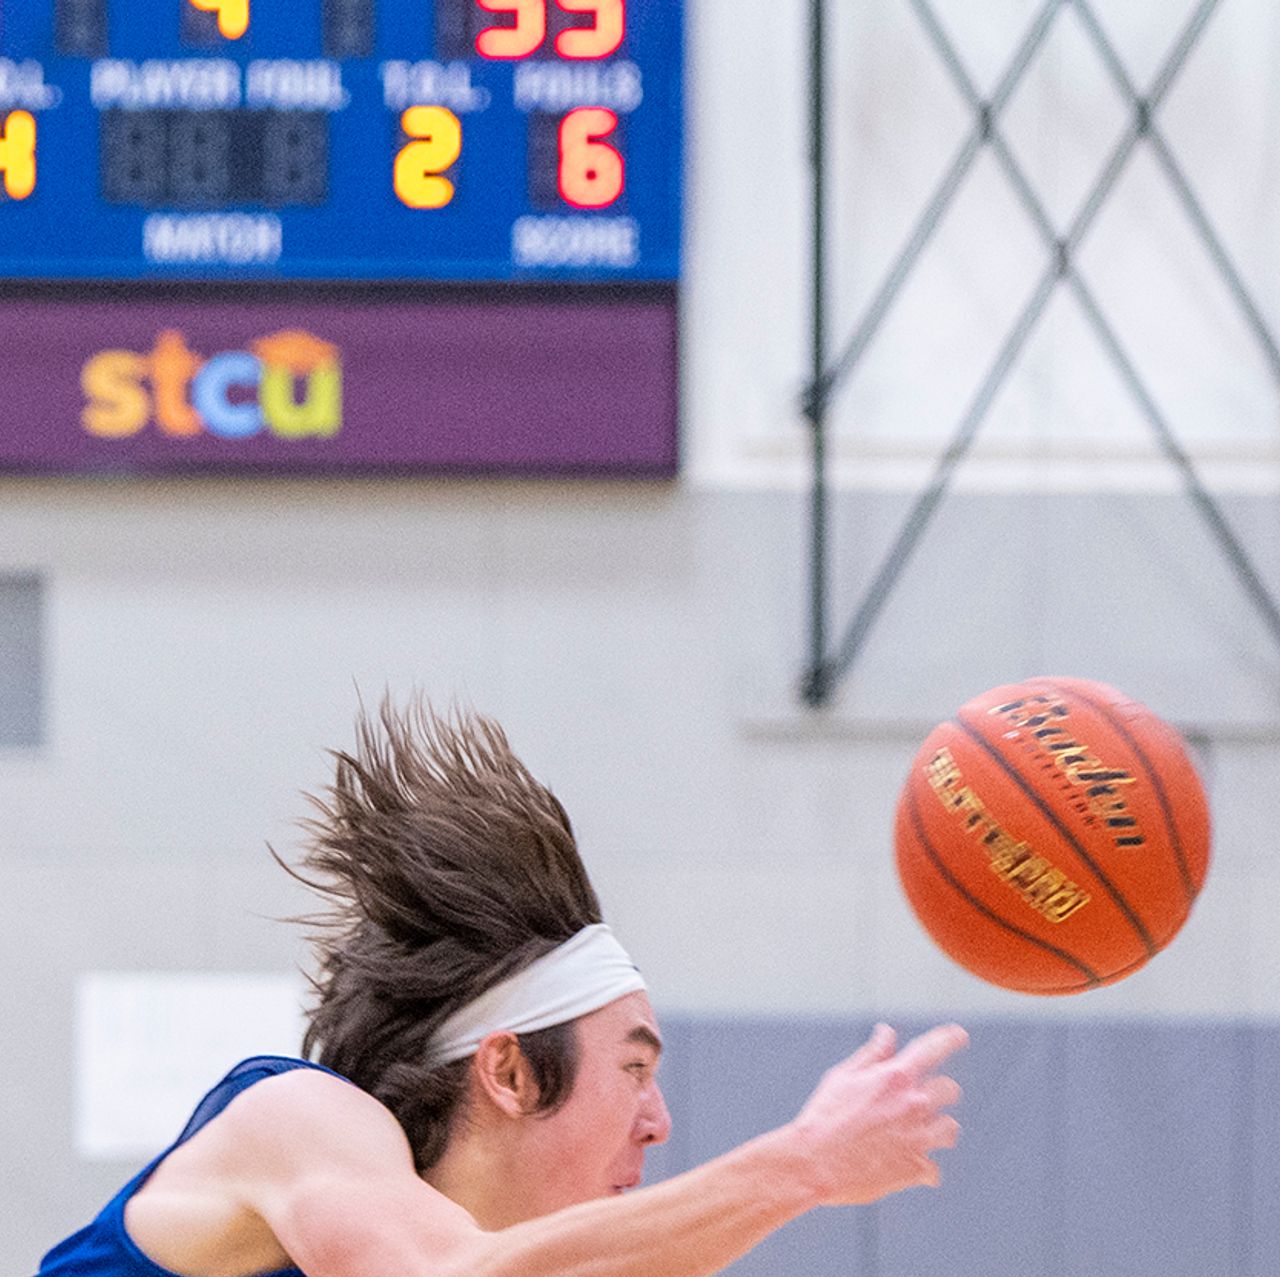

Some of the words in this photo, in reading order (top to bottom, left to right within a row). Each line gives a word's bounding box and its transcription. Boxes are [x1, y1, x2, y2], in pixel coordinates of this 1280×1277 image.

[393, 105, 462, 209] 2
[558, 106, 625, 209] 6
[80, 328, 344, 439] stcu
